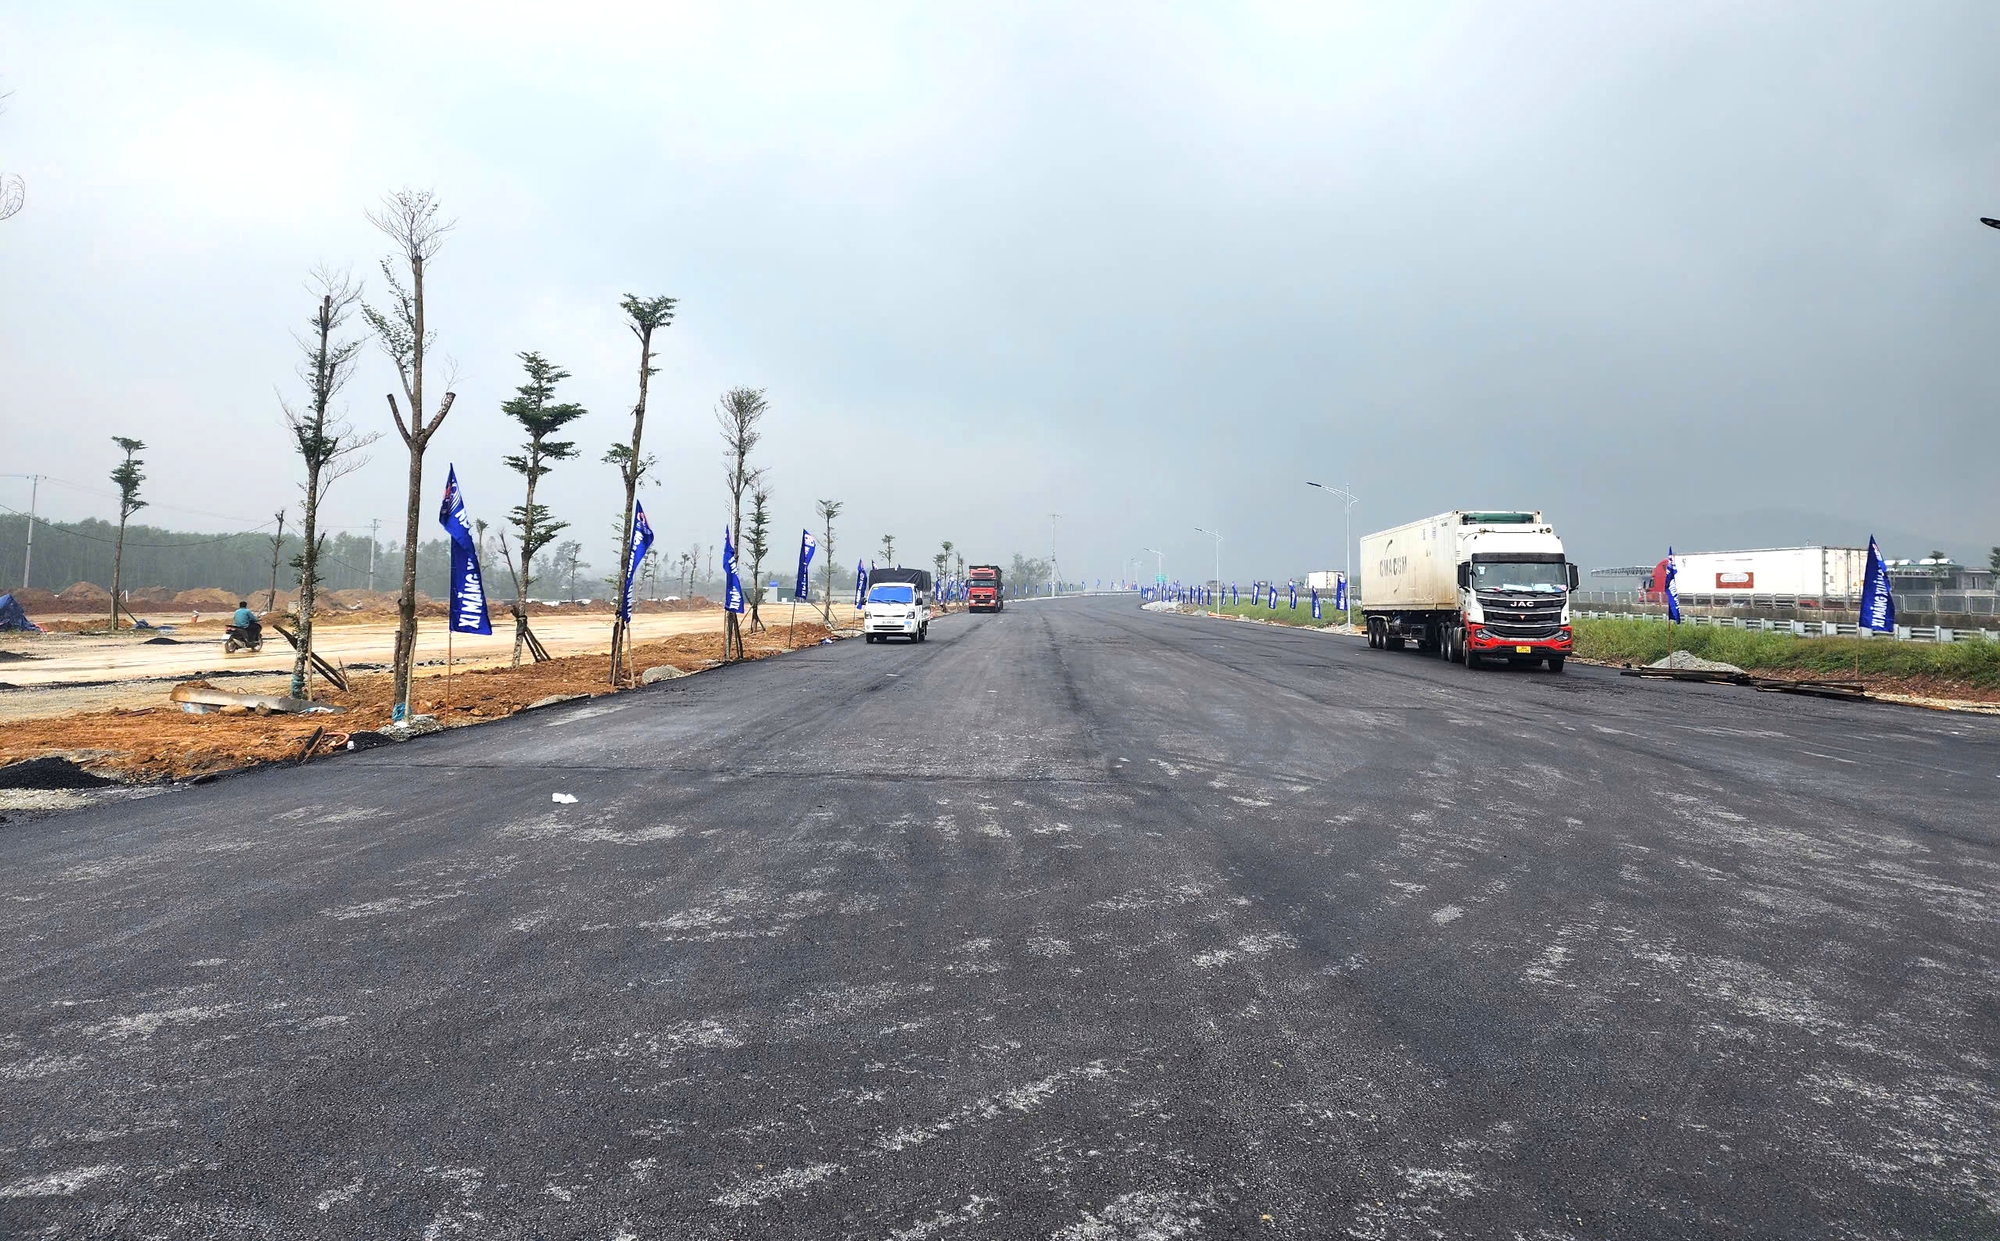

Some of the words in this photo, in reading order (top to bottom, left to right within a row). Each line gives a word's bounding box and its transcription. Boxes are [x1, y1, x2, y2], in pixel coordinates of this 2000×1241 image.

[1870, 596, 1888, 619] MĂNG
[458, 614, 481, 629] XI
[1871, 619, 1885, 628] XI
